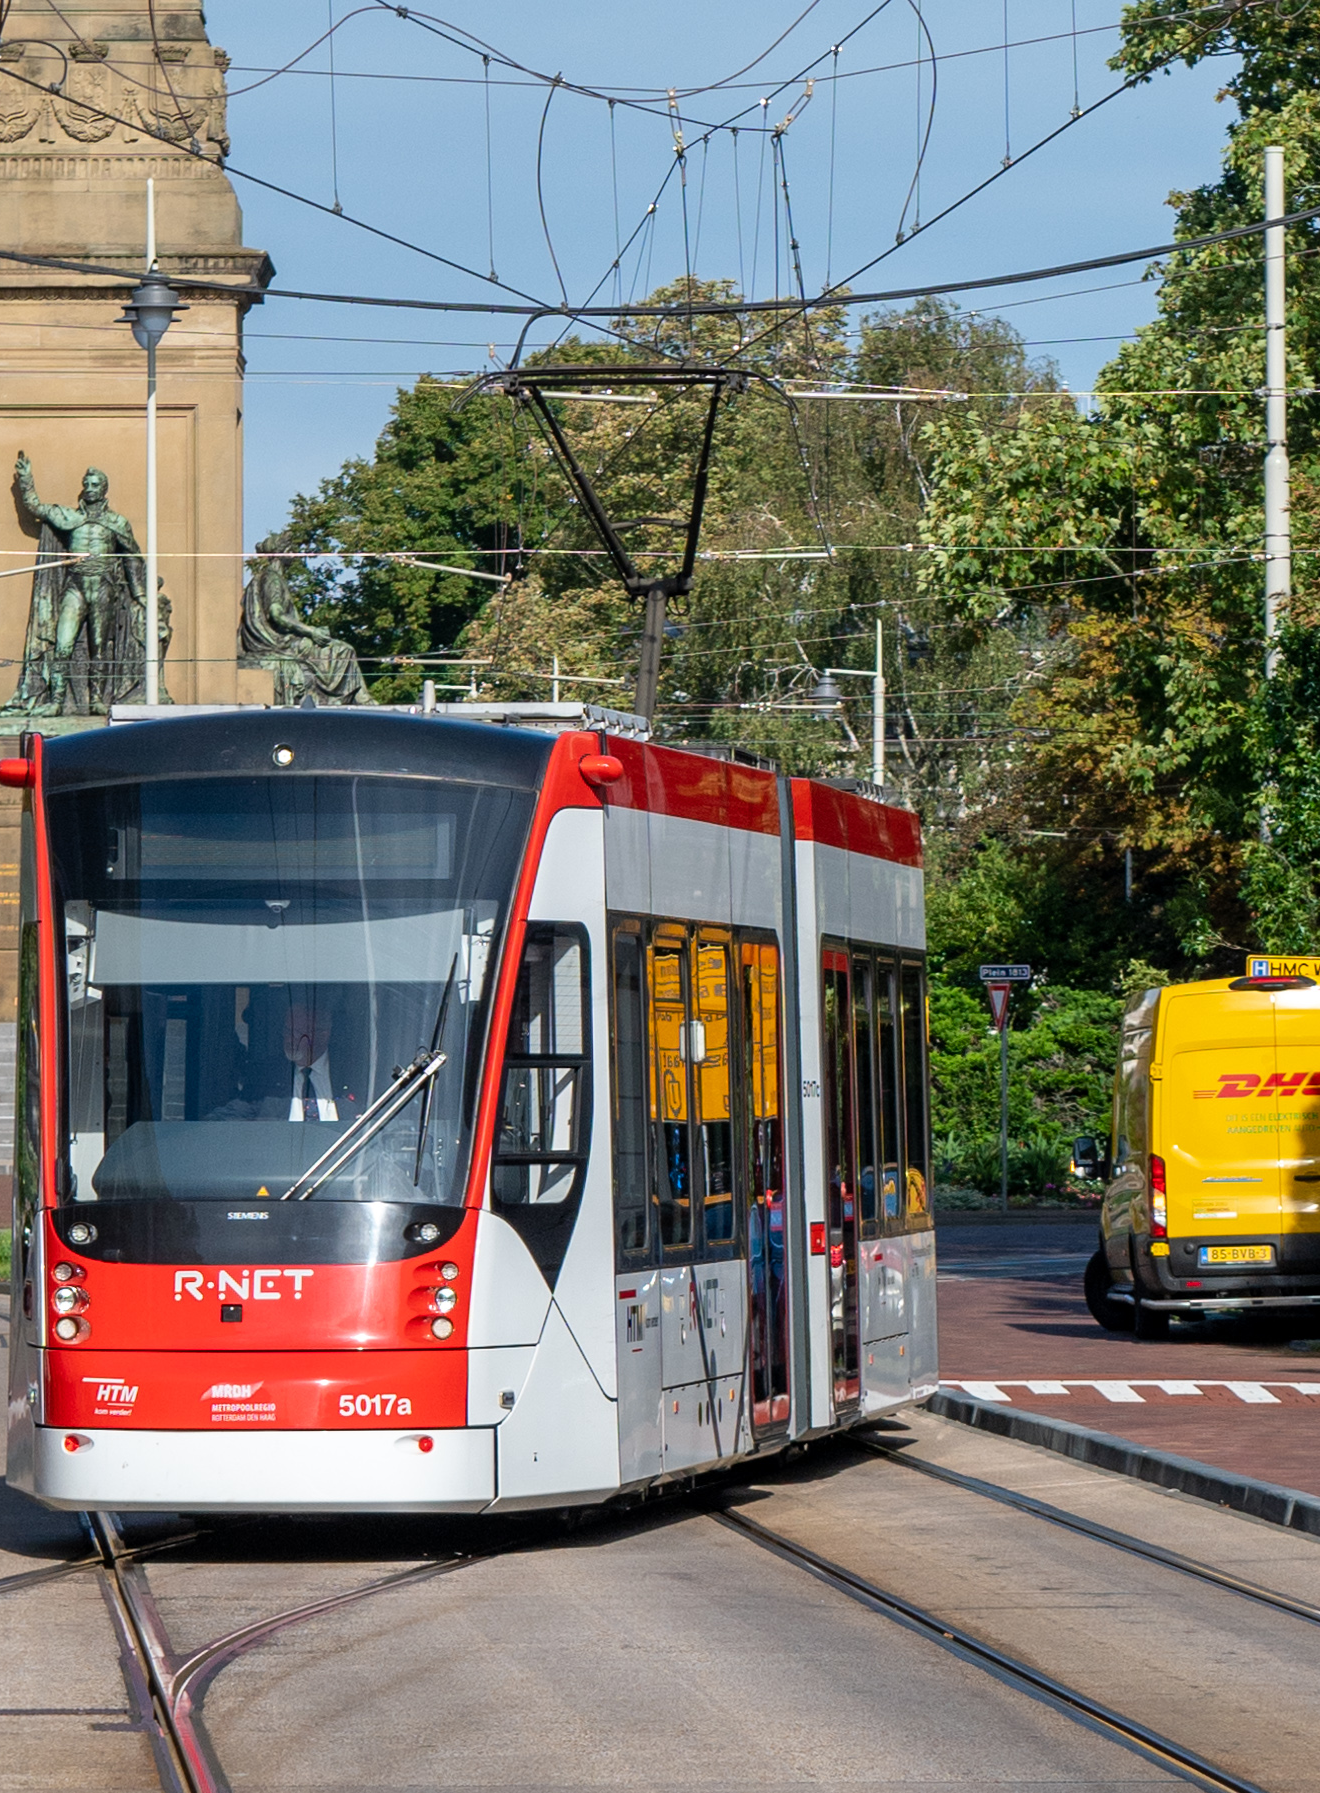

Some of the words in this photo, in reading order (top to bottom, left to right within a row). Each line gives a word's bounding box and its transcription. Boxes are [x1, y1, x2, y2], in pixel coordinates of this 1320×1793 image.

[982, 968, 1007, 976] Plein
[1270, 963, 1309, 976] HMC
[227, 1211, 269, 1220] SIEMENS
[1211, 1248, 1267, 1260] 85-BVB-3
[96, 1384, 139, 1403] HTM
[211, 1384, 252, 1399] MRDH
[211, 1403, 276, 1412] METROPOOLREGIO
[338, 1393, 412, 1417] 5017a
